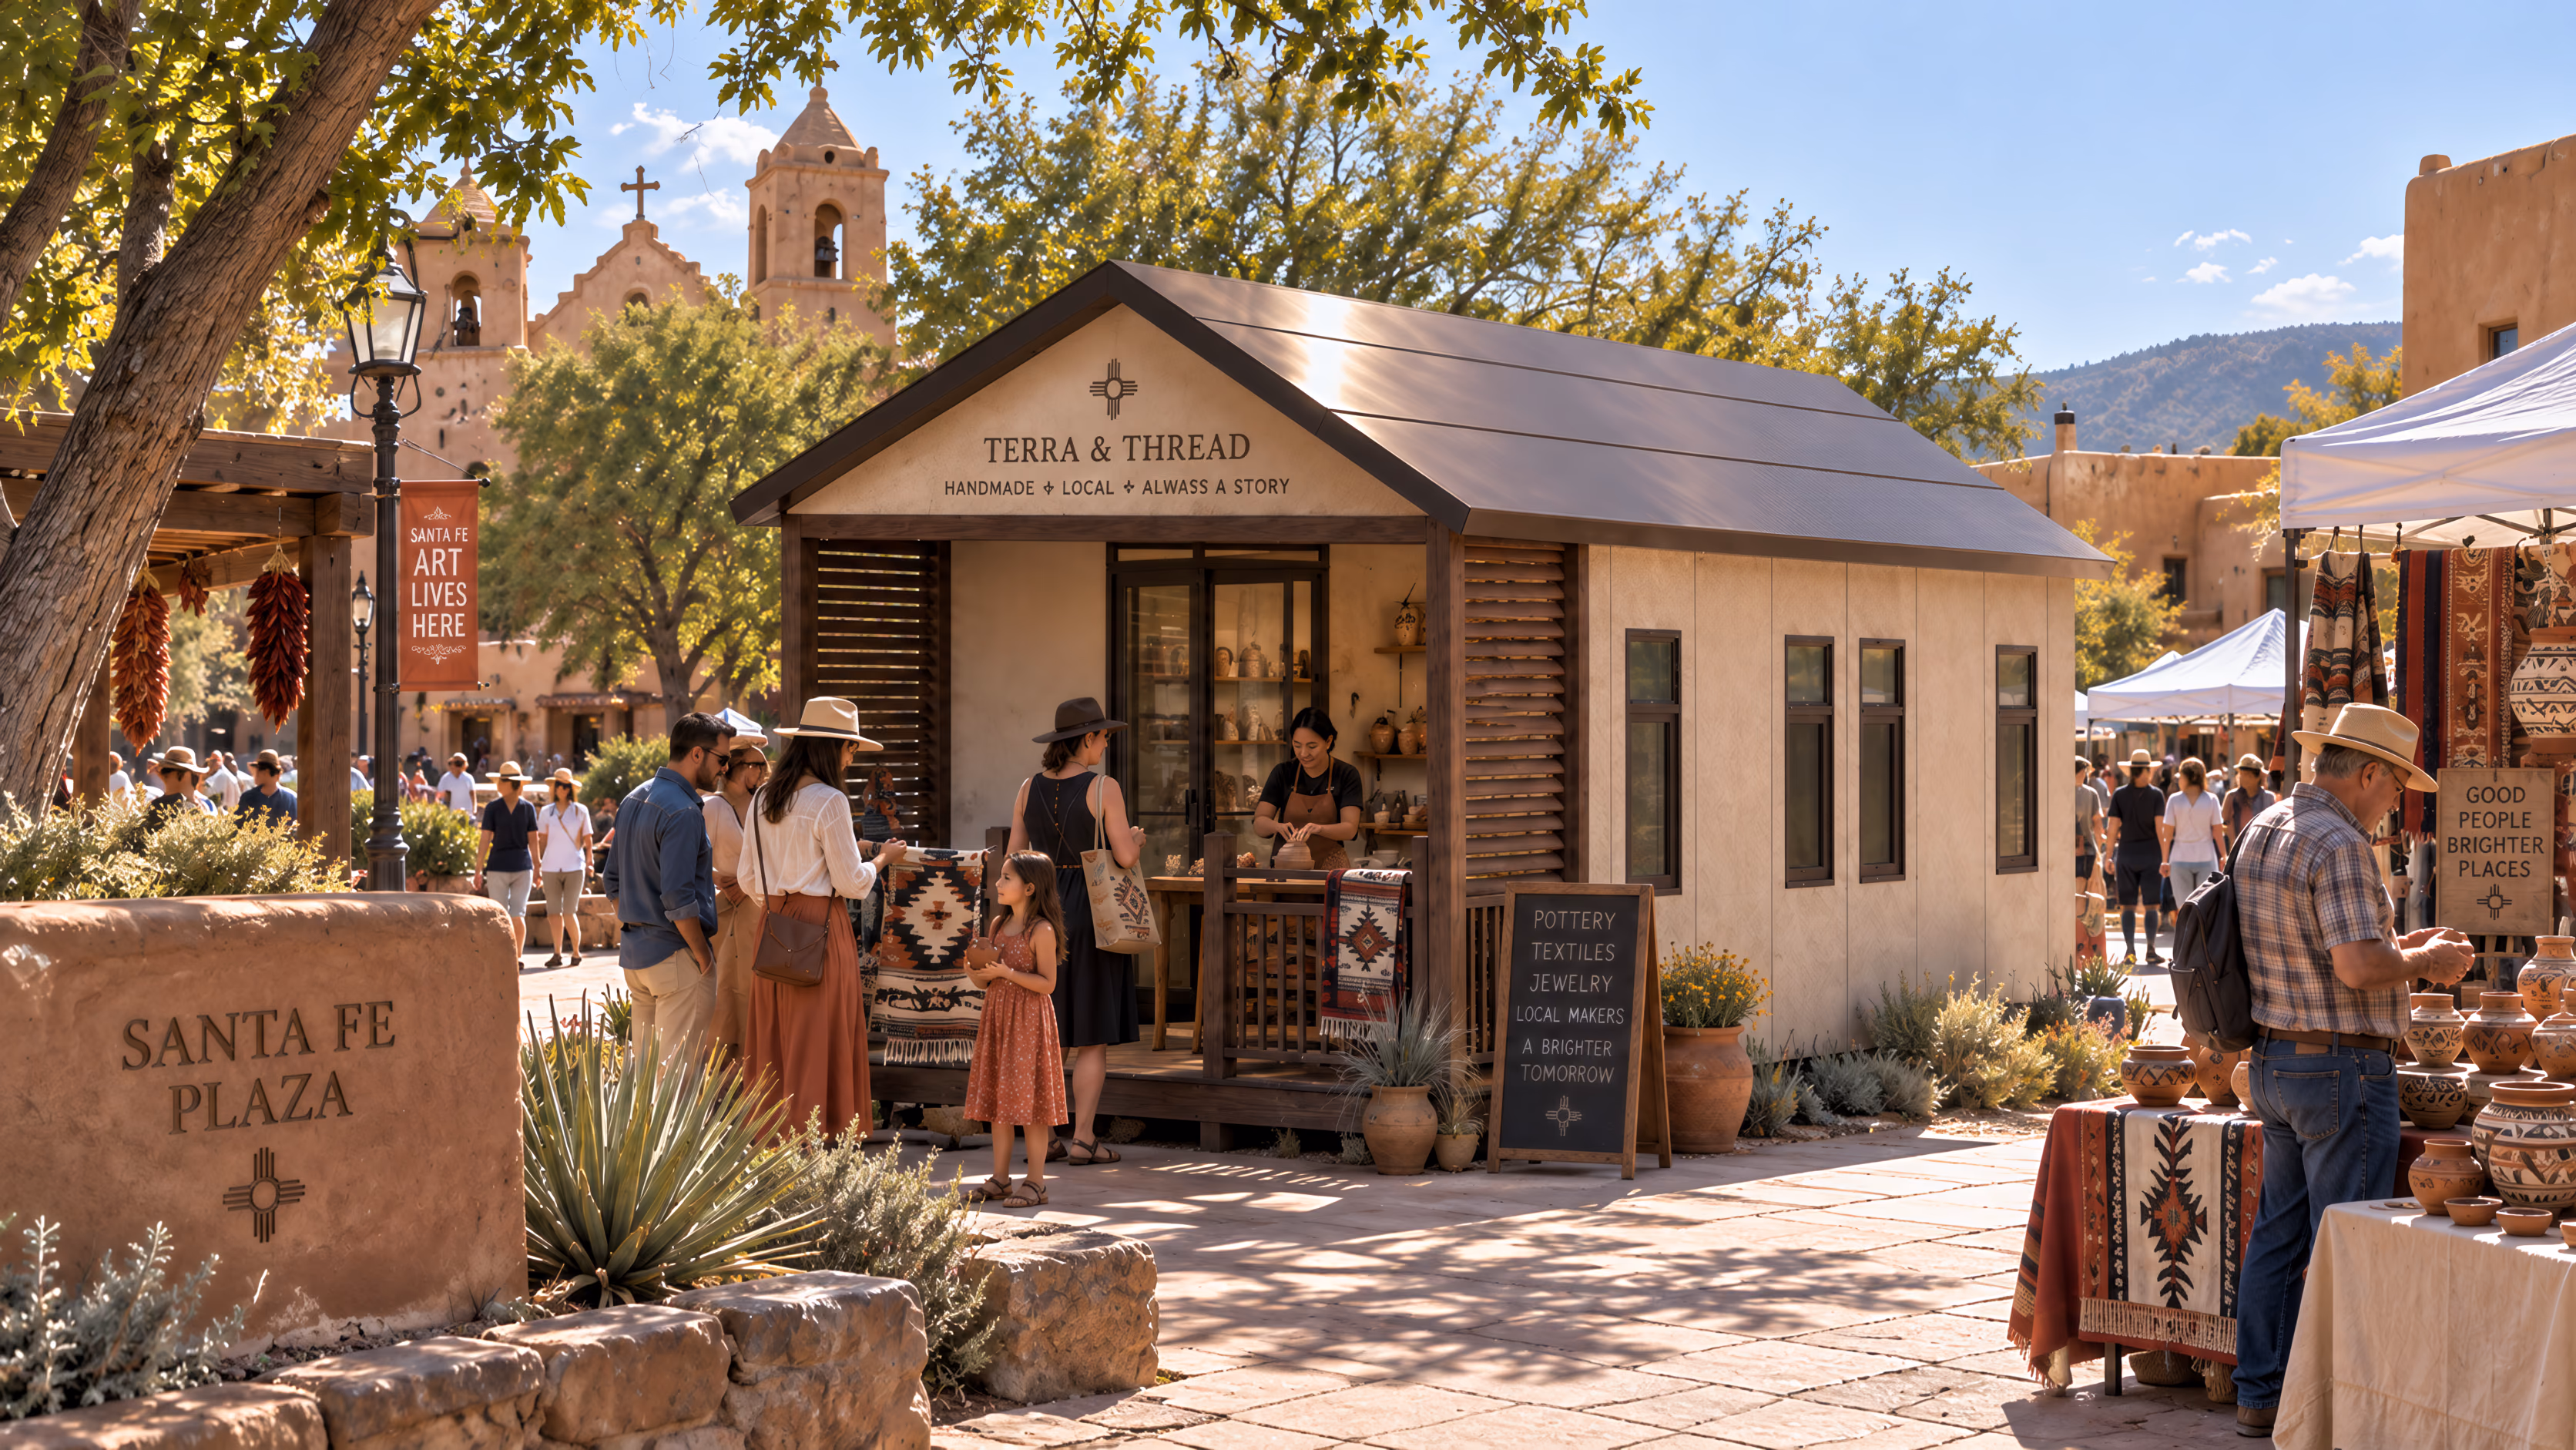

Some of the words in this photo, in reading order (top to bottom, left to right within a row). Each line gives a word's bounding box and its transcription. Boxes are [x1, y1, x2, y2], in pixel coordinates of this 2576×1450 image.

[984, 437, 1079, 462] TERRA
[1091, 436, 1111, 462] &
[1122, 433, 1250, 461] THREAD
[945, 481, 1034, 495] HANDMADE
[1063, 480, 1114, 495] LOCAL
[1142, 479, 1208, 494] ALWASS
[1216, 479, 1226, 494] A
[1234, 478, 1290, 494] STORY
[411, 528, 450, 542] SANTA
[455, 528, 468, 542] FE
[414, 549, 462, 576] ART
[412, 582, 467, 606] LIVES
[413, 613, 465, 637] HERE
[2467, 787, 2525, 803] GOOD
[2460, 811, 2531, 828] PEOPLE
[2448, 837, 2544, 854] BRIGHTER
[2460, 861, 2530, 878] PLACES
[1535, 910, 1615, 929] POTTERY
[1532, 942, 1615, 962] TEXTILES
[1530, 974, 1612, 992] JEWELRY
[1517, 1006, 1560, 1022] LOCAL
[1569, 1007, 1624, 1024] MAKERS
[122, 1008, 315, 1071] SANTA
[334, 1001, 395, 1051] FE
[1522, 1038, 1532, 1054] A
[1542, 1039, 1612, 1056] BRIGHTER
[1521, 1064, 1614, 1083] TOMORROW
[168, 1070, 353, 1134] PLAZA
